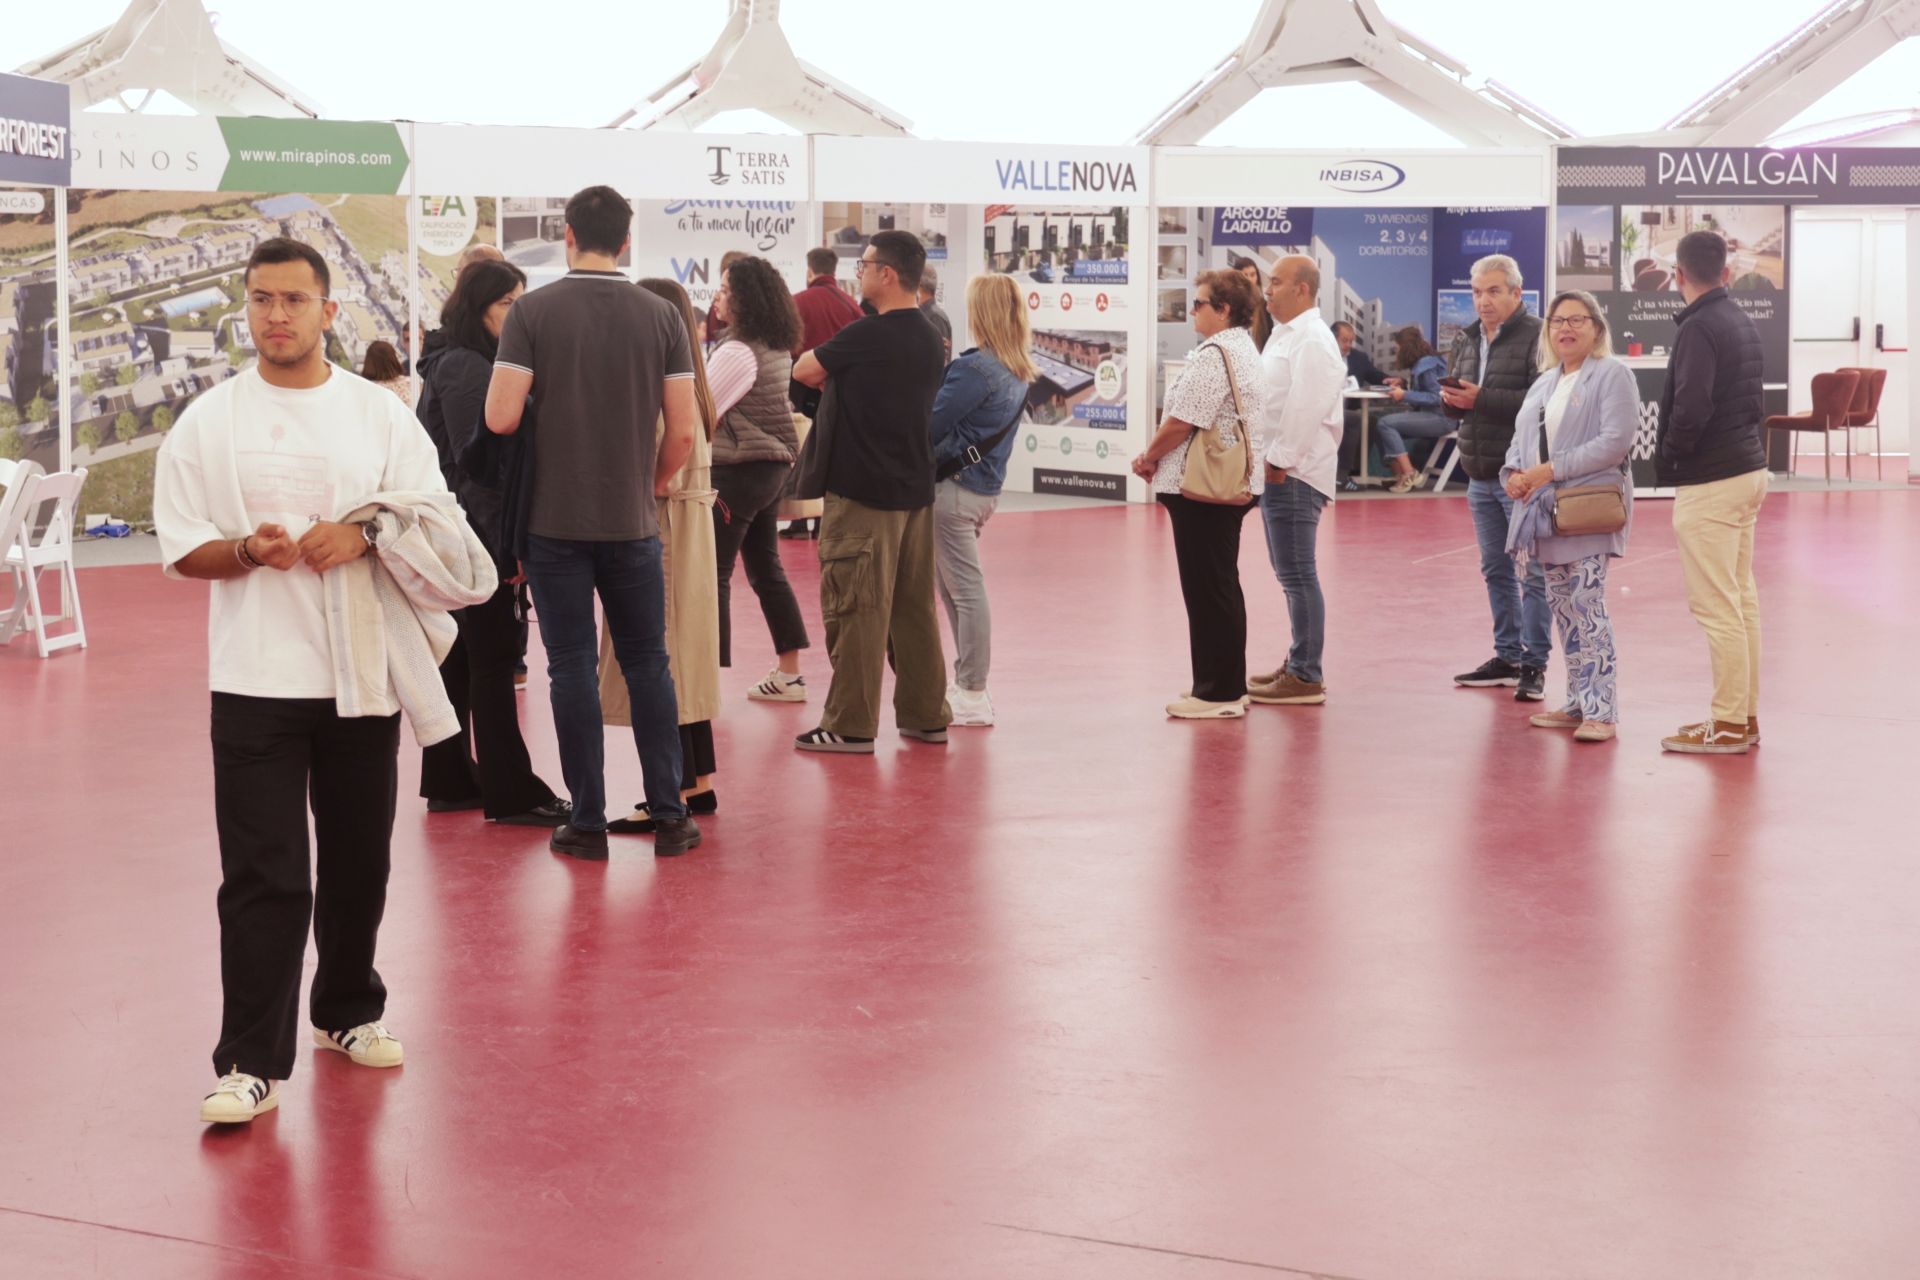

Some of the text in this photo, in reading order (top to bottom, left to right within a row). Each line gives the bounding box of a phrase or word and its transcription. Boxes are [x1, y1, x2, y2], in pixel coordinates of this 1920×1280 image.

[240, 148, 392, 167] www.mirapinos.com
[736, 152, 790, 168] TERRA
[996, 159, 1137, 192] VALLENOVA
[1319, 169, 1384, 182] INBISA
[1657, 152, 1838, 186] PAVALGAN
[742, 170, 785, 186] SATIS
[1221, 207, 1288, 220] ARCO DE
[1364, 214, 1429, 225] 79 VIVIENDAS
[678, 209, 796, 251] a tu nuevo hogar
[1221, 220, 1292, 234] LADRILLO
[1396, 230, 1405, 242] 3
[1408, 232, 1416, 244] y
[1419, 230, 1428, 242] 4
[1358, 246, 1429, 257] DORMITORIOS
[1087, 263, 1119, 274] 350.000
[1085, 408, 1118, 419] 255.000
[1040, 475, 1117, 490] www.vallenova.es
